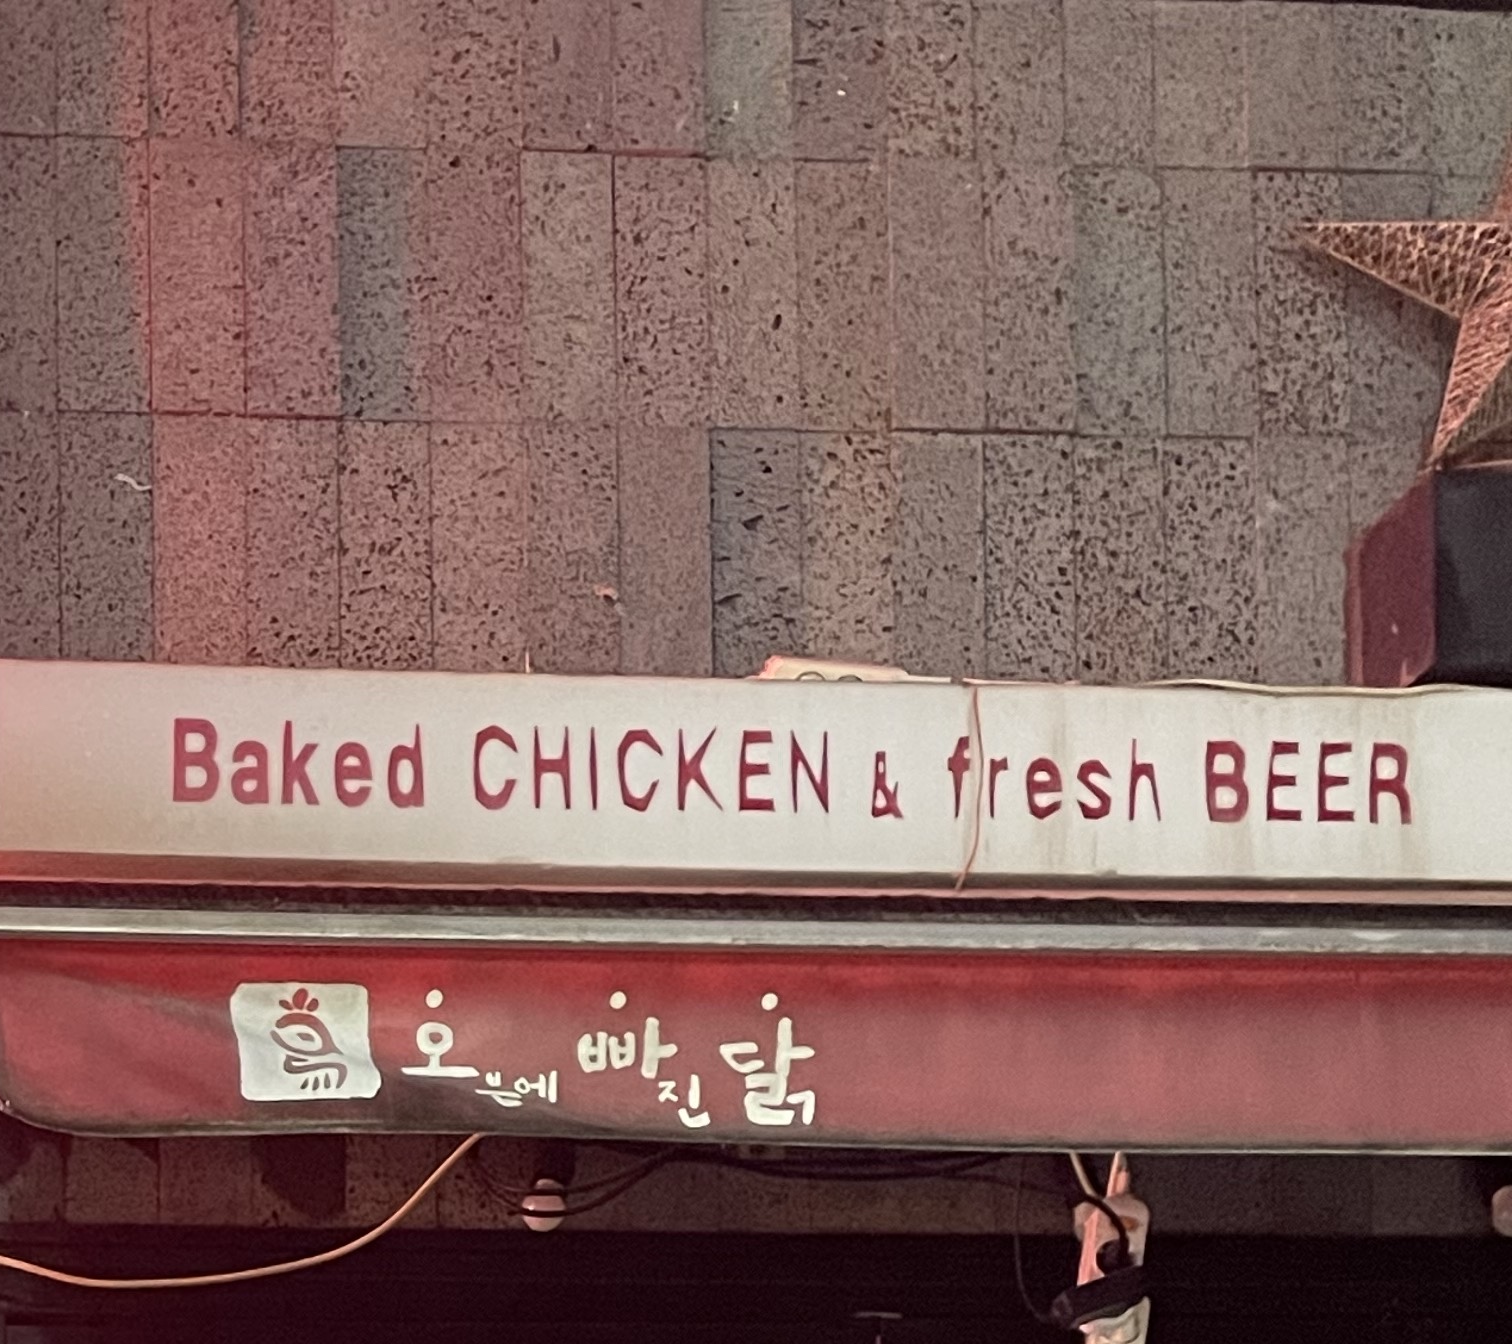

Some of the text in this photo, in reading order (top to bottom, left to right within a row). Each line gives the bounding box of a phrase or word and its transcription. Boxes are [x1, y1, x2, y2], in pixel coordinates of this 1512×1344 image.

[172, 717, 1412, 826] Baked CHICKEN & fresh BEER
[401, 1005, 816, 1128] 오븐에 빠진 닭
